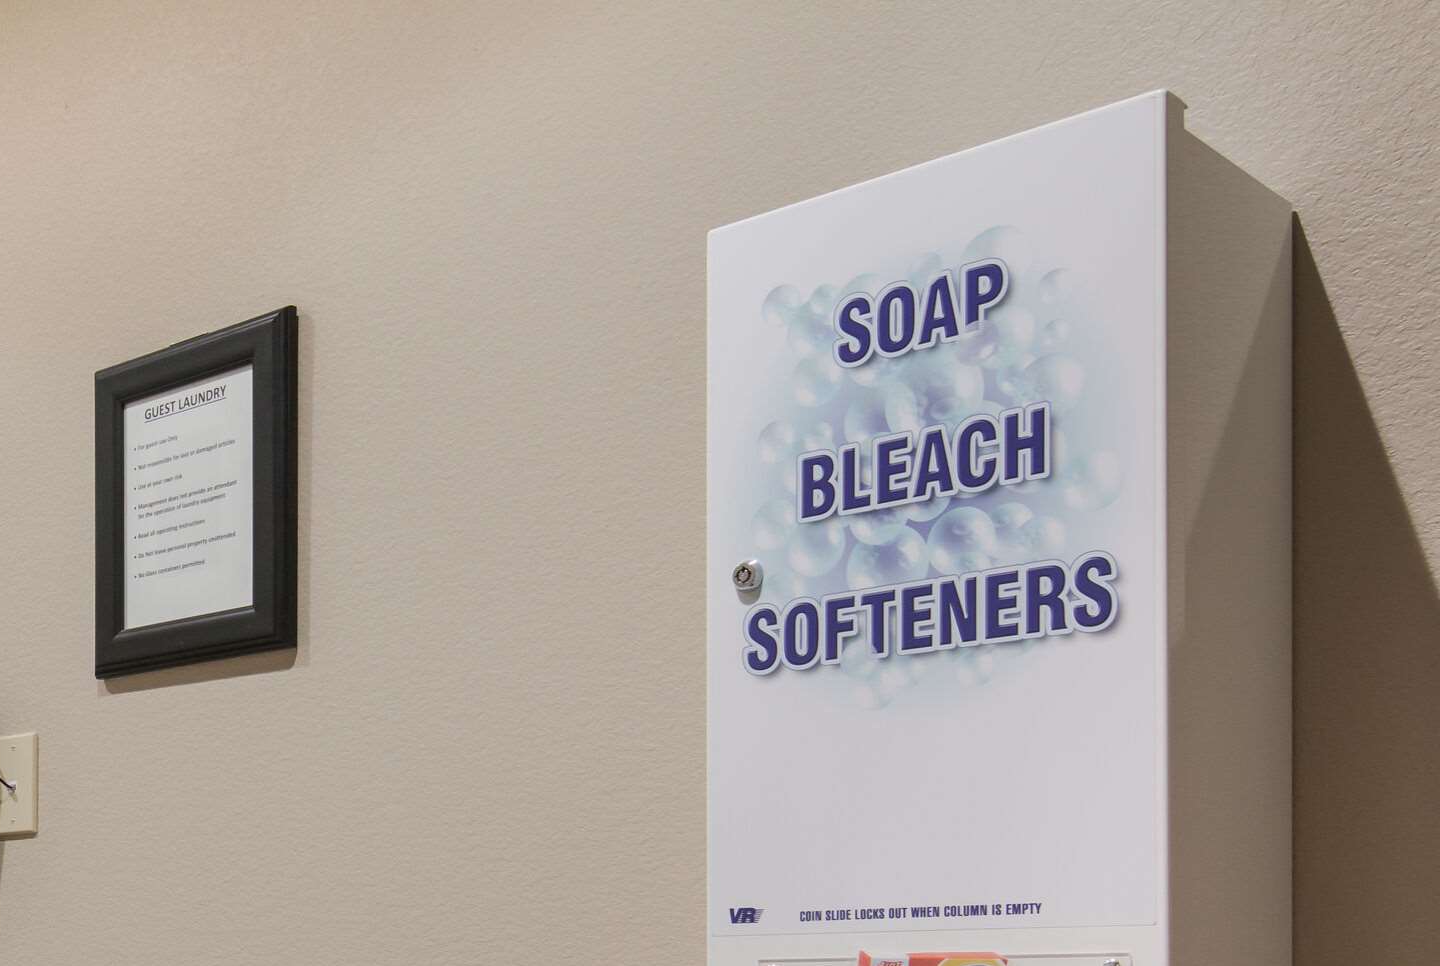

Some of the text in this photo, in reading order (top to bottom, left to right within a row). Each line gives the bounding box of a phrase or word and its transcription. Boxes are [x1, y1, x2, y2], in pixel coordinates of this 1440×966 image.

[835, 260, 1006, 366] SOAP
[144, 385, 226, 420] GUEST LAUNDRY
[799, 403, 1049, 521] BLEACH
[744, 553, 1116, 674] SOFTENERS
[799, 902, 1042, 922] COIN SLIDE LOCKS OUT WHEN COLUMN IS EMPTY
